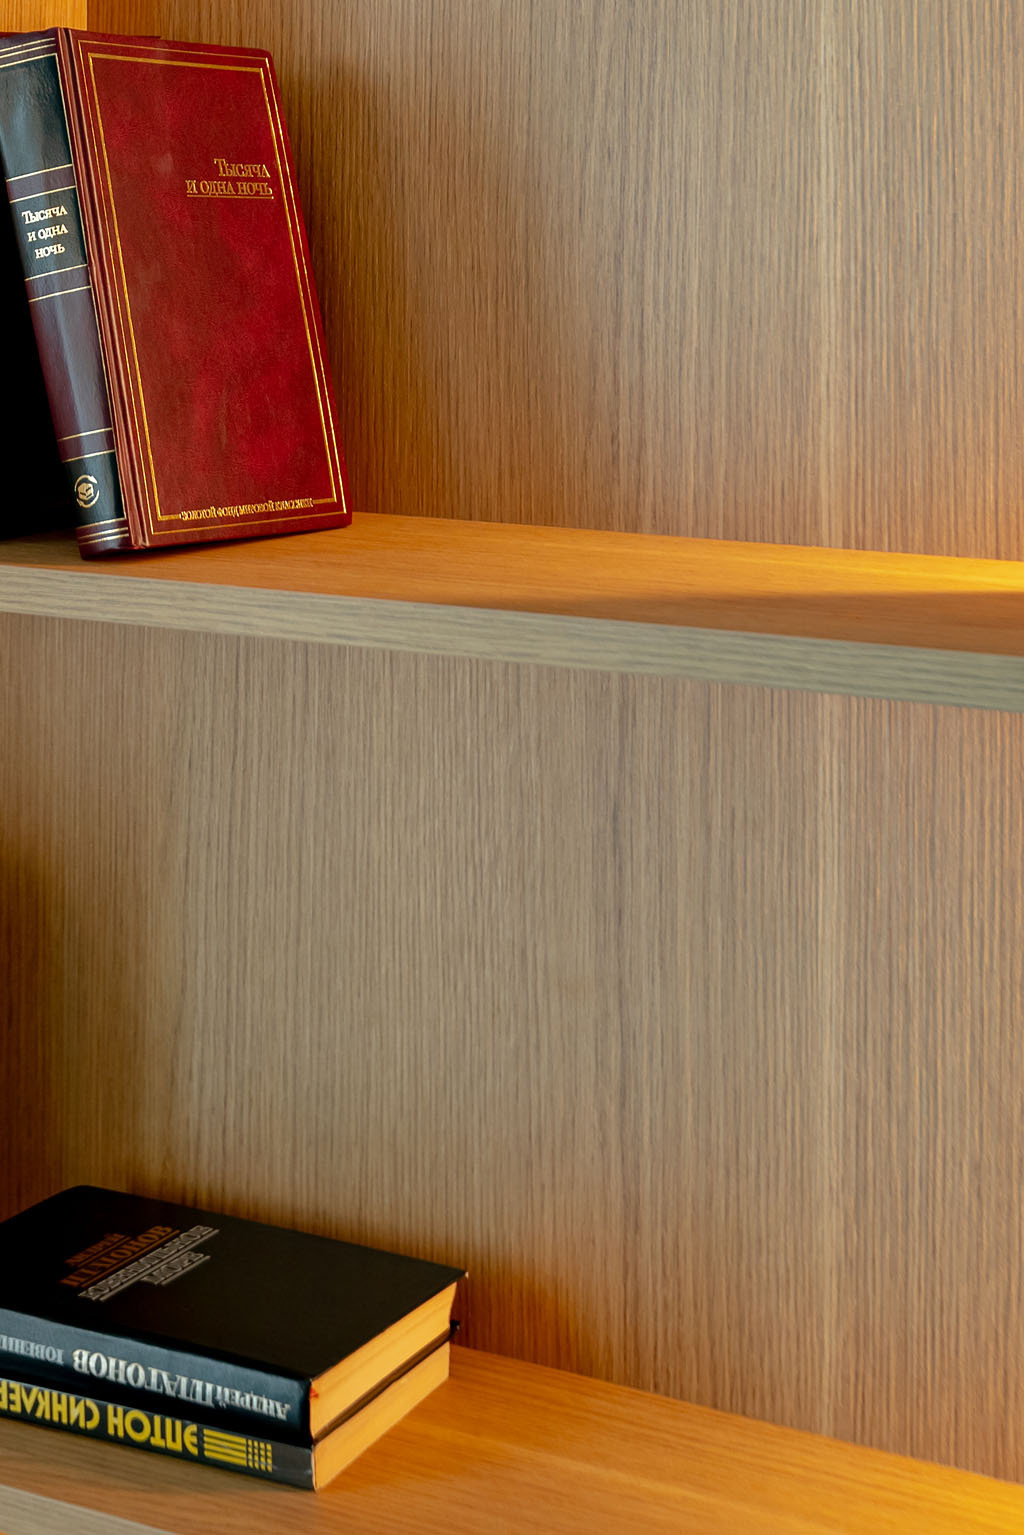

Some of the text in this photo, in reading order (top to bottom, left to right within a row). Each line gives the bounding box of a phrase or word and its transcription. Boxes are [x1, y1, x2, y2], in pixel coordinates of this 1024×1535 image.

[199, 180, 236, 196] ОДНА
[236, 182, 273, 195] НОЧЬ
[37, 224, 69, 240] ОДНА
[34, 244, 66, 259] НОЧЬ
[72, 1348, 216, 1408] ПЛАТОНОВ
[216, 1384, 291, 1422] АНДРЕЙ
[107, 1402, 198, 1457] ЭПТОН
